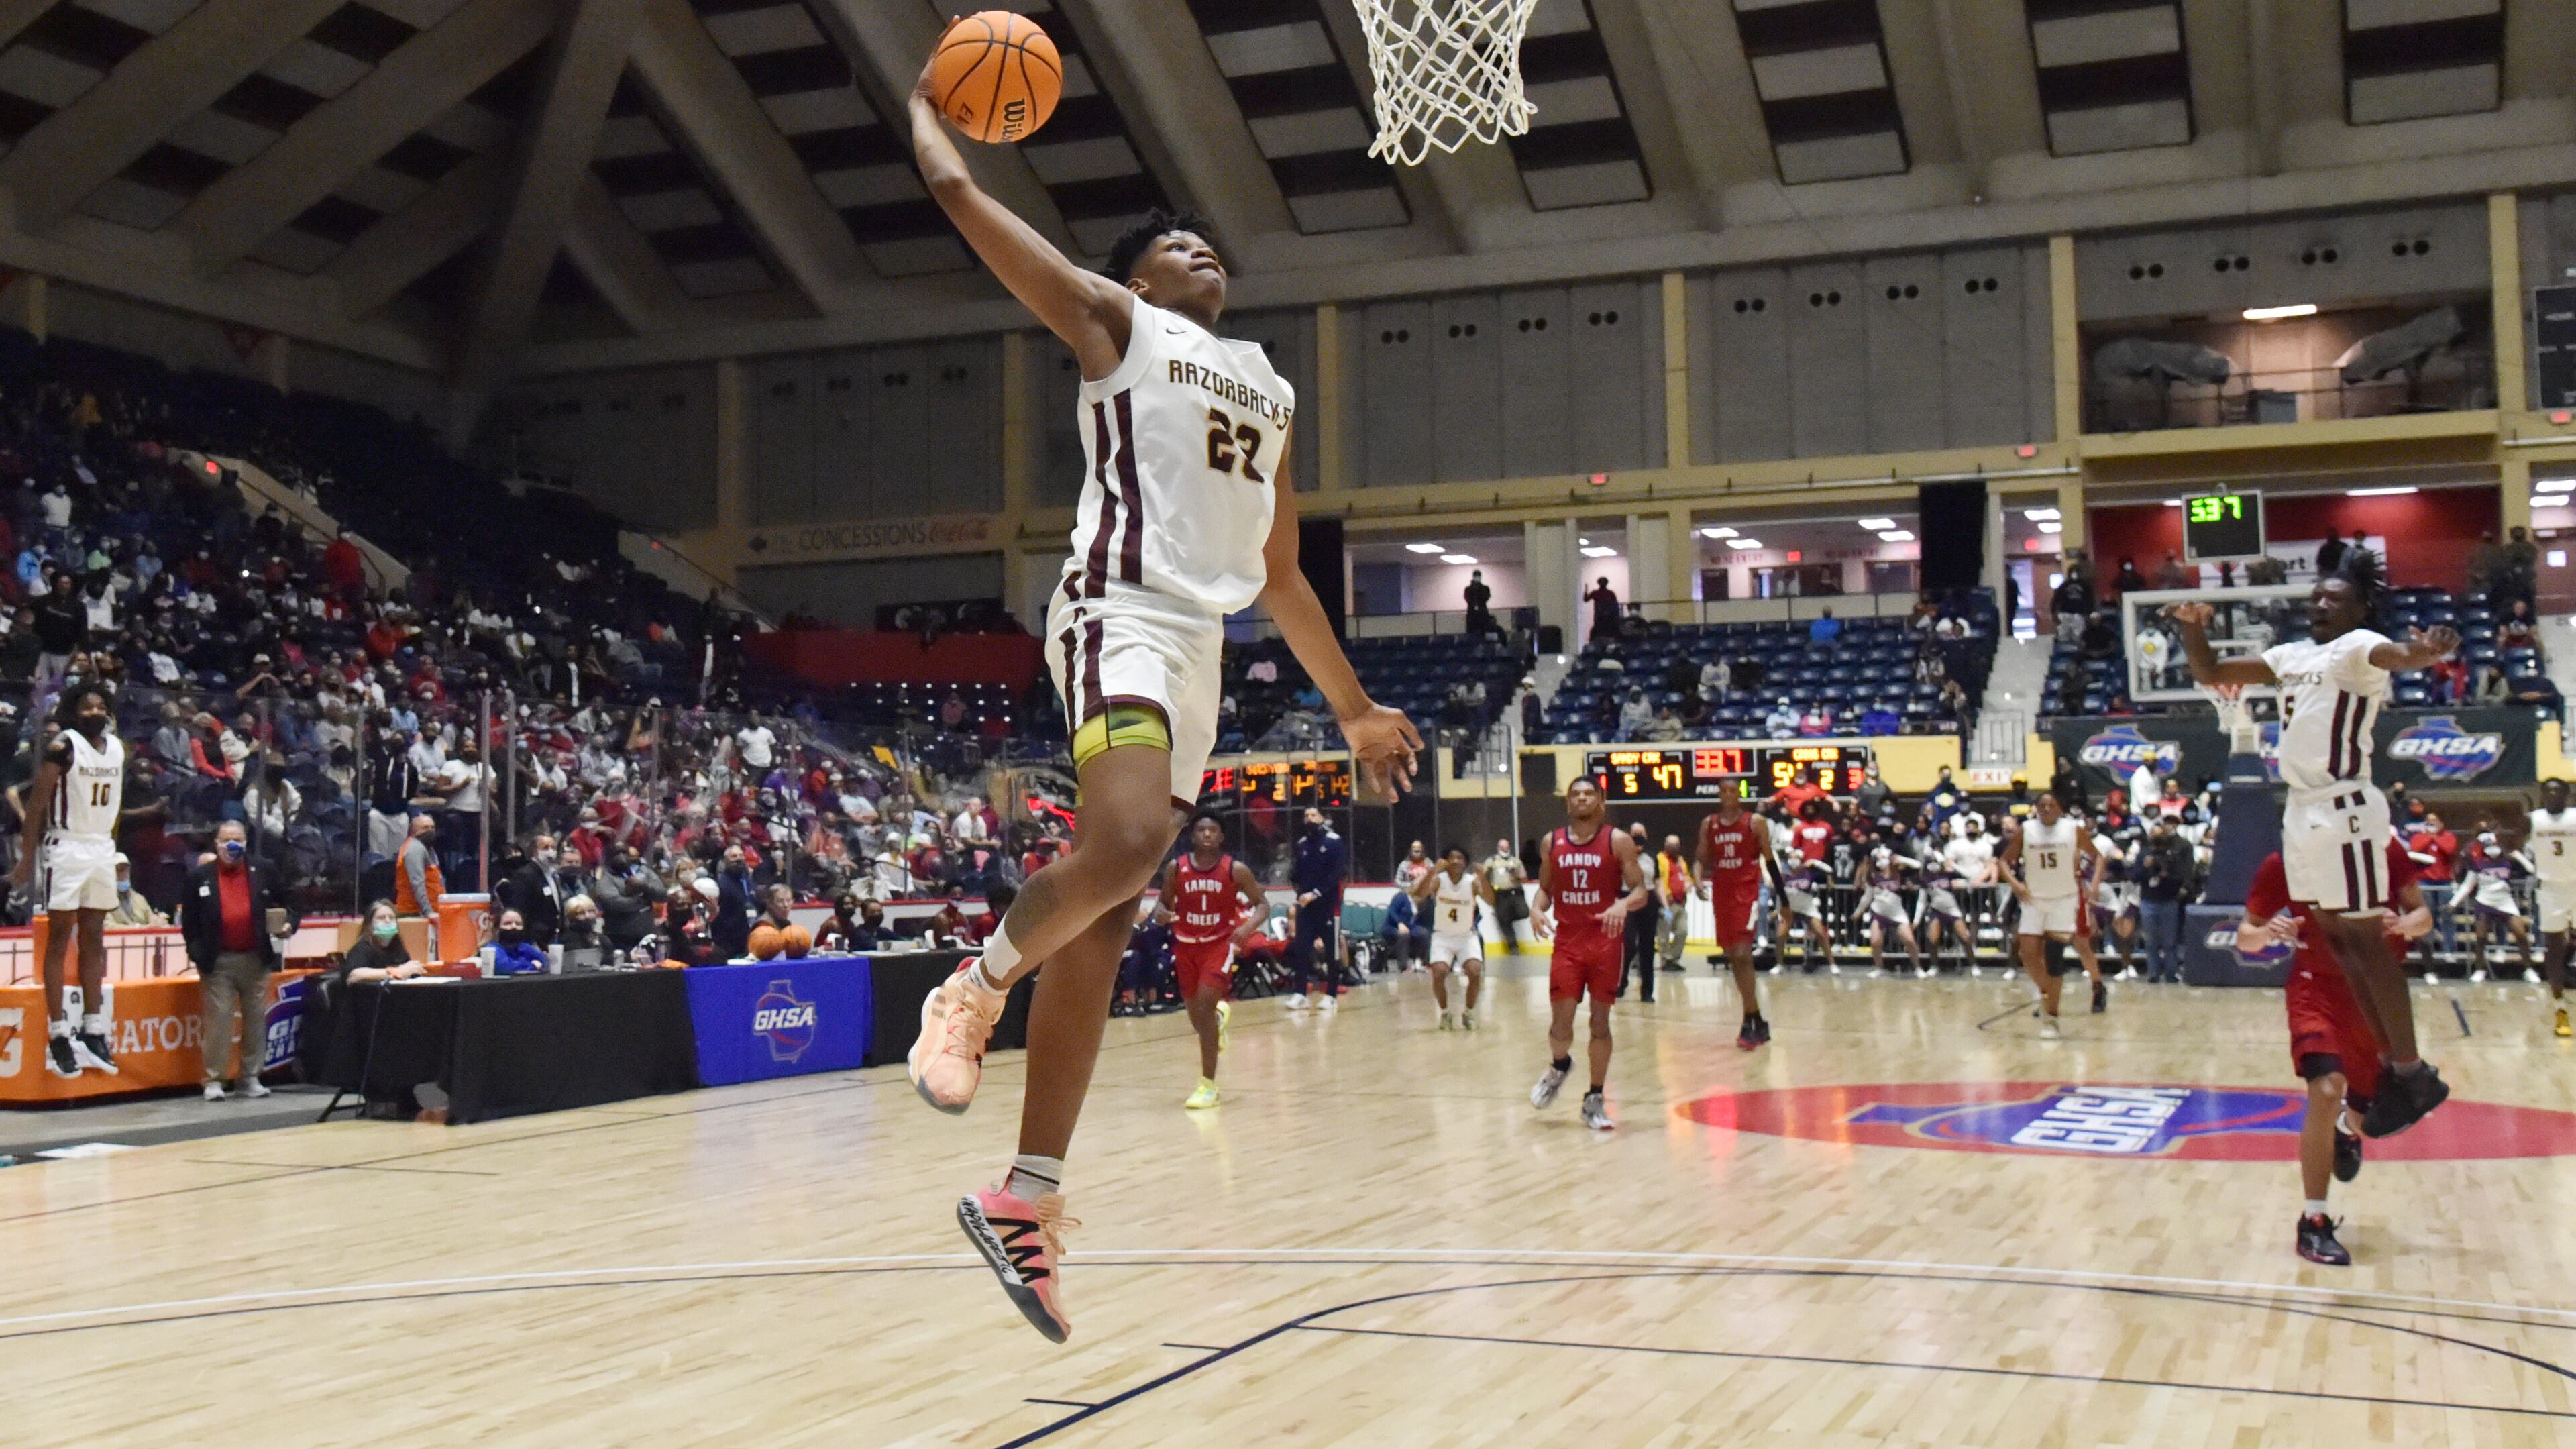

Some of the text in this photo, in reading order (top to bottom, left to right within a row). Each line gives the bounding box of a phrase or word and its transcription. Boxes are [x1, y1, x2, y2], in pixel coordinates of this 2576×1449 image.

[1169, 359, 1292, 431] RAZORBACKS
[1208, 406, 1265, 484] 22
[2082, 744, 2176, 764] GHSA
[2392, 736, 2498, 756] GHSA
[1695, 748, 1742, 775] 33.7
[1623, 773, 1638, 794] 5
[1652, 763, 1682, 790] 47
[1819, 769, 1834, 791] 2
[91, 782, 111, 806] 10
[2349, 815, 2360, 834] C
[1558, 853, 1601, 869] SANDY
[2040, 851, 2057, 869] 15
[1184, 879, 1222, 894] SANDY
[1572, 869, 1588, 889] 12
[1201, 894, 1207, 912] 1
[1562, 890, 1600, 904] CREEK
[1186, 912, 1220, 926] CREEK
[1448, 908, 1458, 922] 4
[753, 1006, 814, 1031] GHSA
[2010, 1085, 2192, 1152] GHSA
